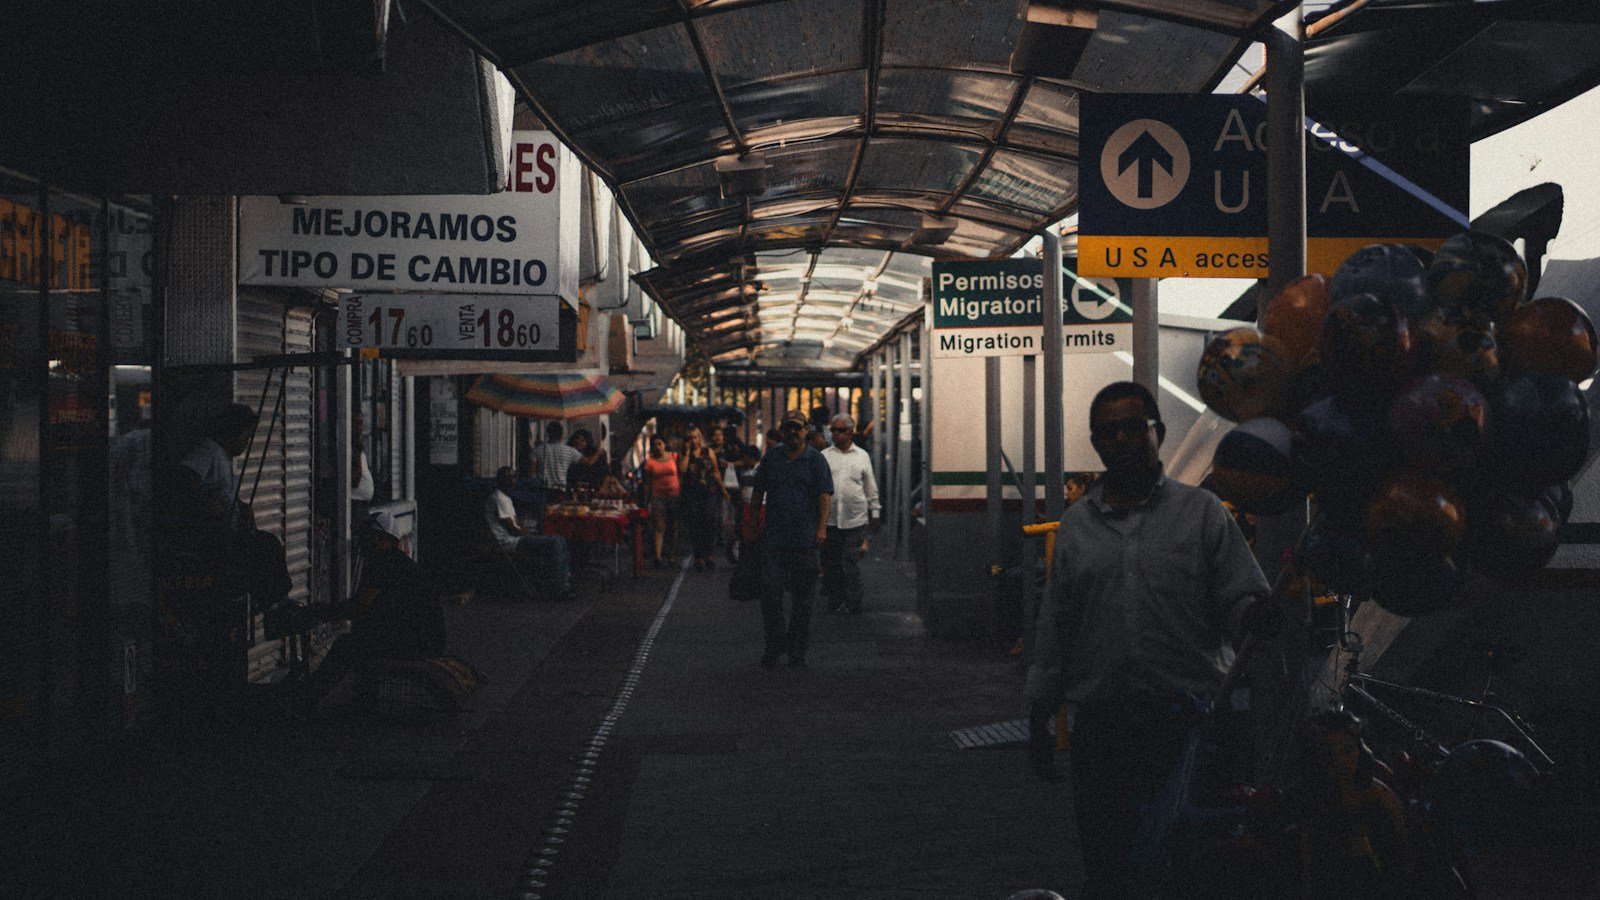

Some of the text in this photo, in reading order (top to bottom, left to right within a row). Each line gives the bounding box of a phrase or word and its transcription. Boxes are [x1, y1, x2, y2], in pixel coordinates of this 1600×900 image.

[1213, 108, 1392, 153] Aceso
[506, 143, 555, 193] ES
[1214, 169, 1360, 214] UA
[292, 207, 517, 242] MEJORAMOS
[259, 250, 547, 286] TIPO DE CAMBIO
[1195, 252, 1268, 269] acces
[939, 271, 1043, 292] Permisos
[346, 295, 362, 345] COMPRA
[368, 307, 433, 347] 17 60
[459, 303, 475, 341] VENTA
[940, 295, 1069, 321] Migratoris
[477, 308, 541, 347] 18 60
[940, 330, 1115, 354] Migration rmits
